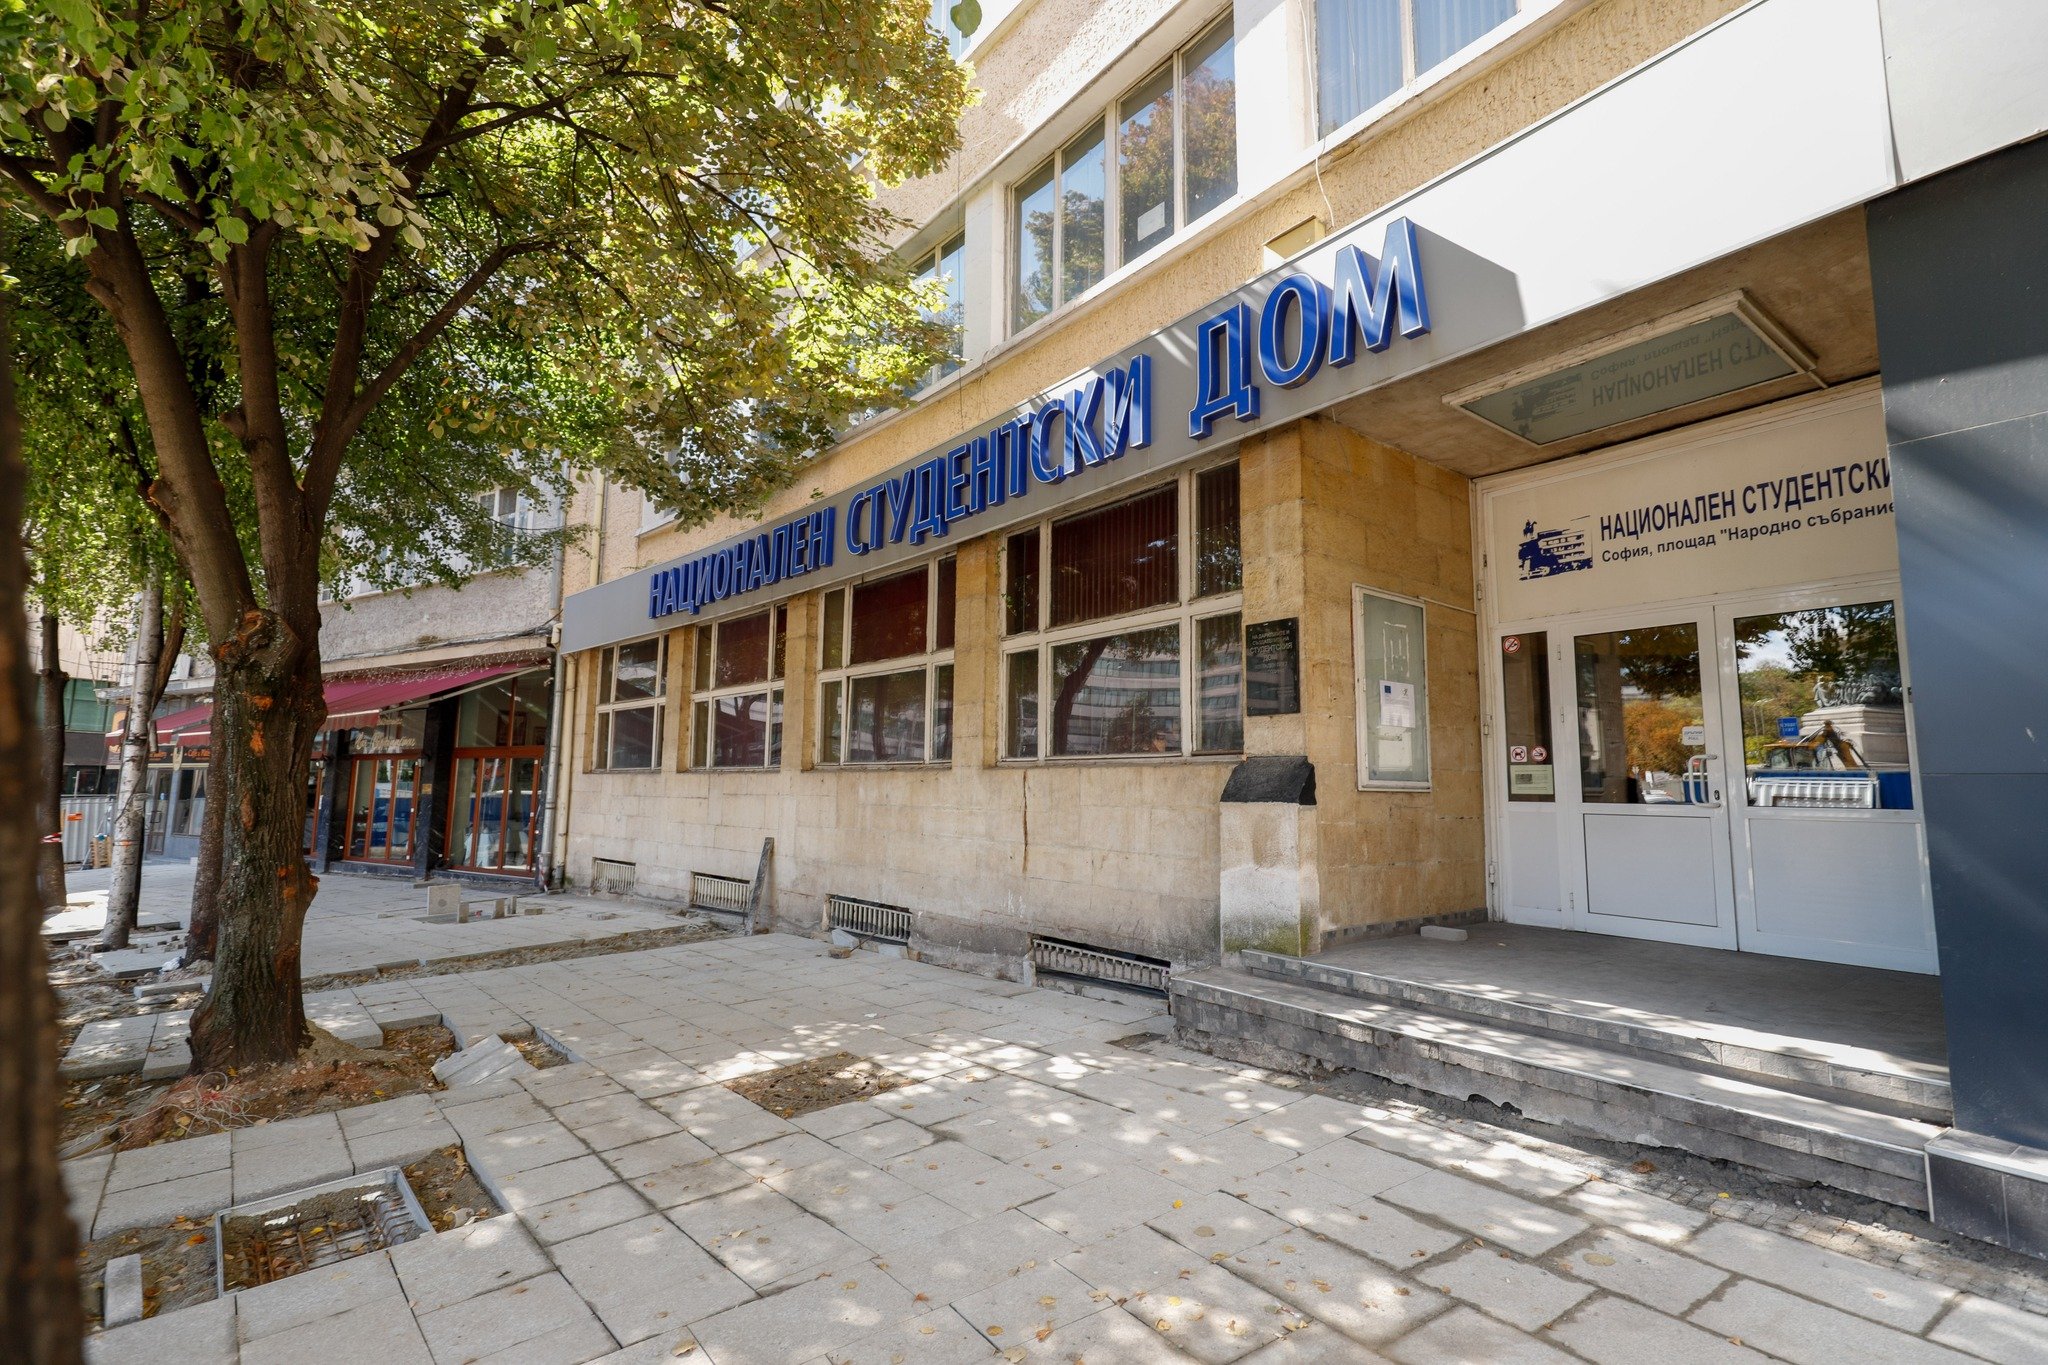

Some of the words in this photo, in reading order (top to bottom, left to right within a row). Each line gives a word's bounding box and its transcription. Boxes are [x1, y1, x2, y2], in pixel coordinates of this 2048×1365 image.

[649, 506, 835, 619] НАЦИОНАЛЕН
[846, 354, 1151, 556] СТУДЕНТСКИ
[1188, 216, 1431, 440] ДОМ
[1600, 489, 1736, 541] НАЦИОНАЛЕН
[1602, 546, 1653, 562] София,
[1657, 534, 1716, 554] площад
[1720, 519, 1801, 541] "Народно
